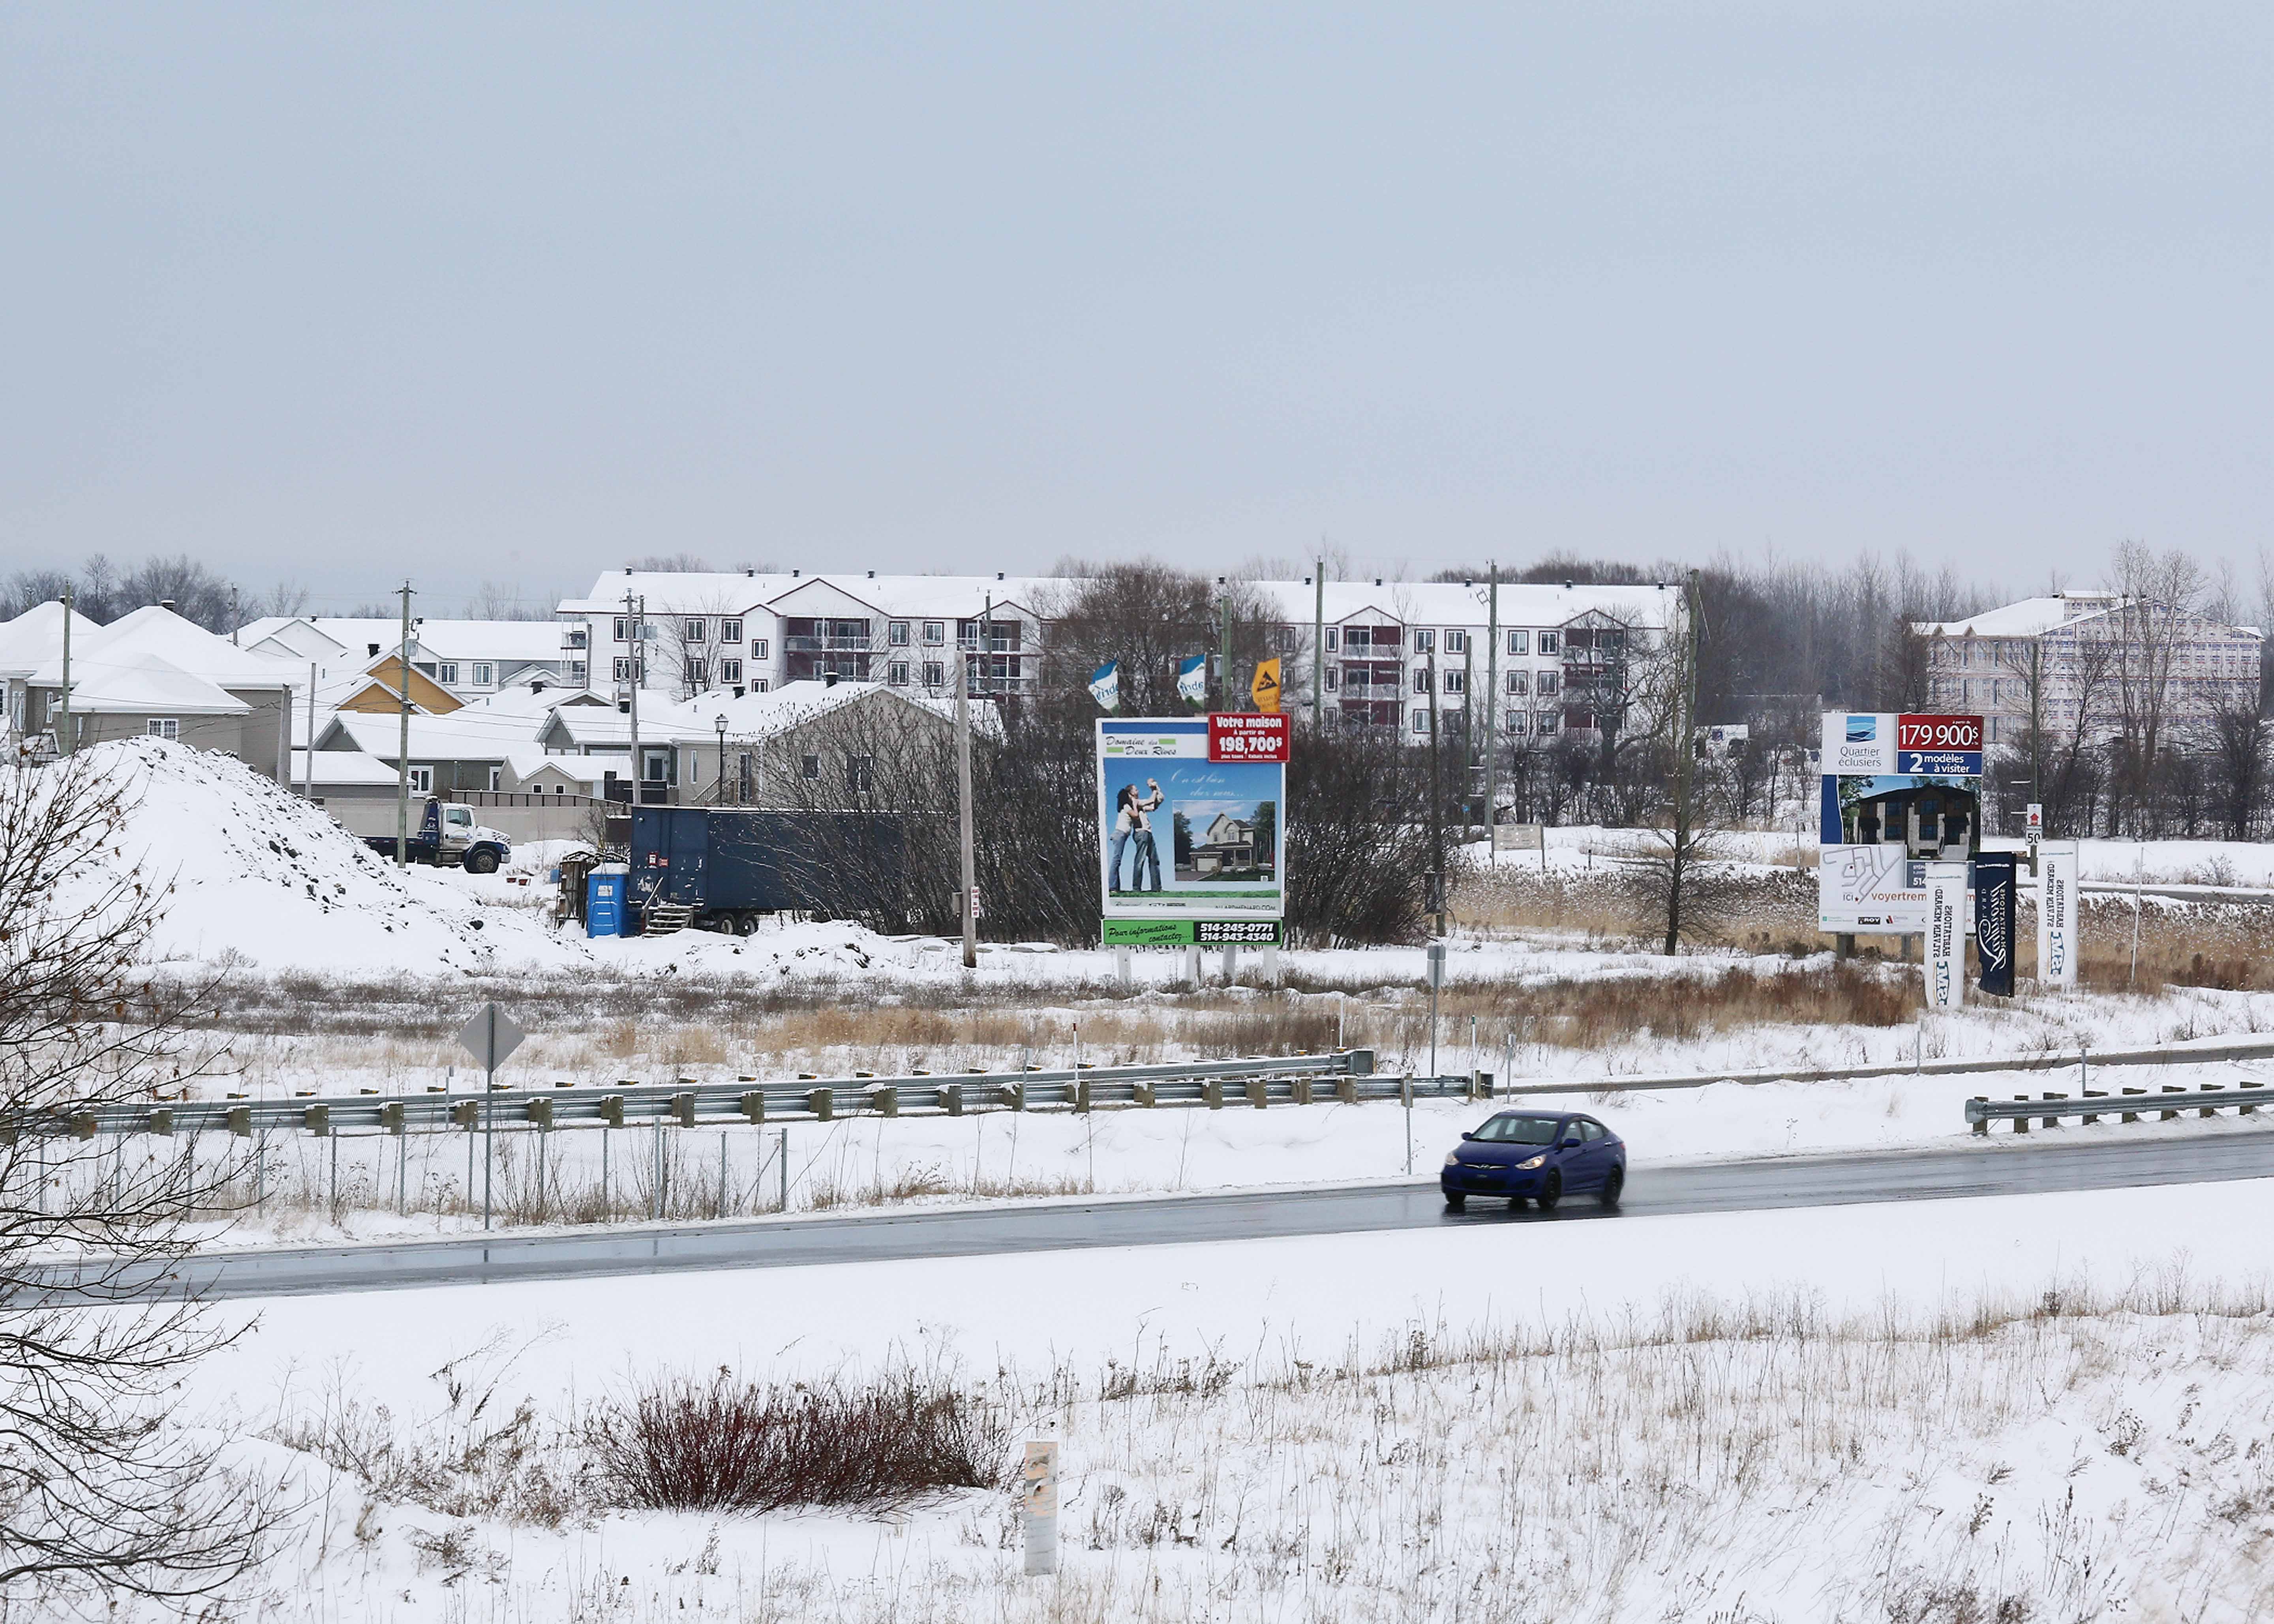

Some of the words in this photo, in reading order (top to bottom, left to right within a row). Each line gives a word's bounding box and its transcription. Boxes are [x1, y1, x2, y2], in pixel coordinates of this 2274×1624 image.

[1216, 716, 1244, 728] Votre
[1246, 716, 1282, 728] maison
[1106, 736, 1145, 745] Domaine
[1900, 725, 1933, 746] 179
[1936, 725, 1979, 746] 900$
[1125, 745, 1148, 755] Deux
[1152, 746, 1176, 755] Rives
[1219, 736, 1282, 754] 198,700$
[1840, 746, 1880, 757] Quartier
[1839, 757, 1882, 767] éclusiers
[1910, 753, 1923, 773] 2
[1924, 753, 1964, 763] modèles
[1934, 763, 1940, 773] à
[1941, 764, 1970, 773] visiter
[2028, 833, 2040, 844] 50
[1109, 927, 1128, 938] Pour
[1129, 925, 1176, 938] informations
[1200, 923, 1274, 932] 514-245-0771
[1200, 933, 1274, 941] 514-943-4340
